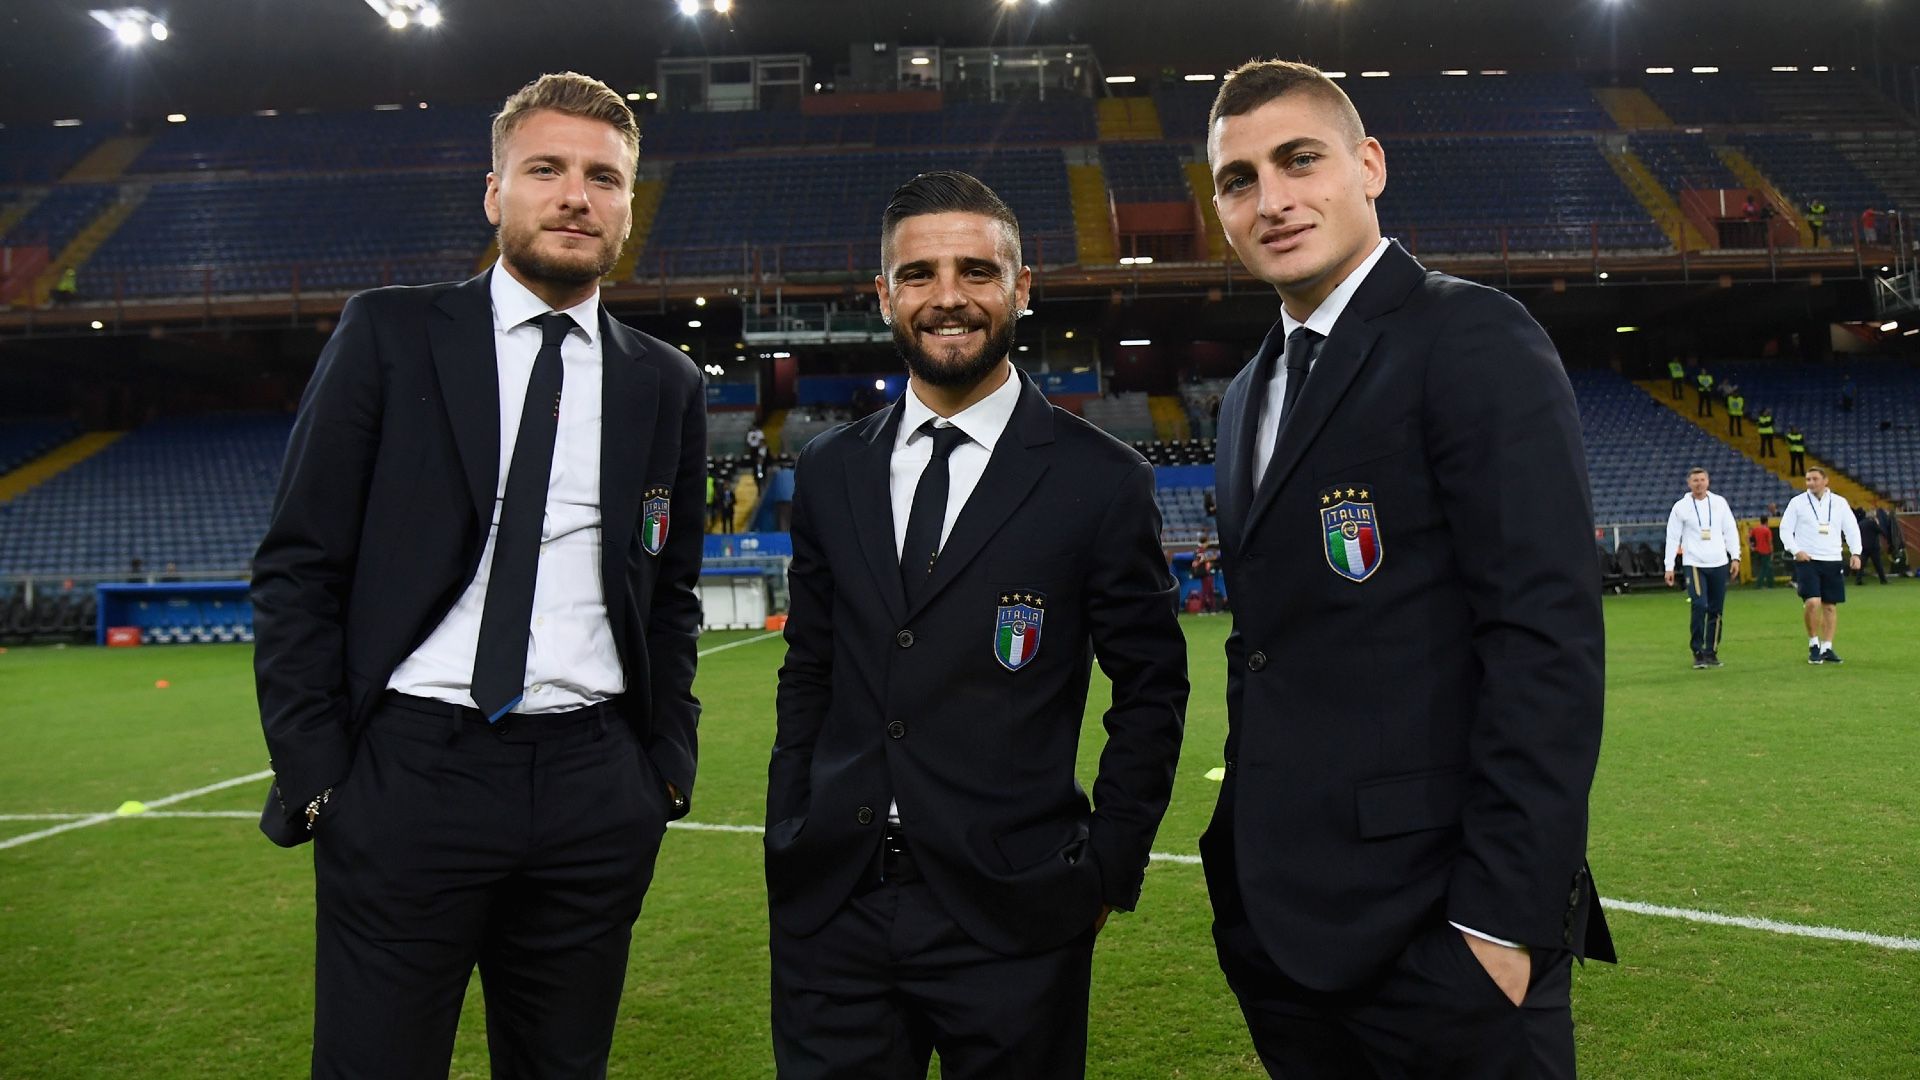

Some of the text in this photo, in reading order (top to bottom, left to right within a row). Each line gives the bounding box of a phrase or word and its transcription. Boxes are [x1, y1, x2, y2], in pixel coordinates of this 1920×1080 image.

[646, 502, 668, 513] ITALIA
[1326, 508, 1370, 525] ITALIA
[1002, 610, 1039, 622] ITALIA
